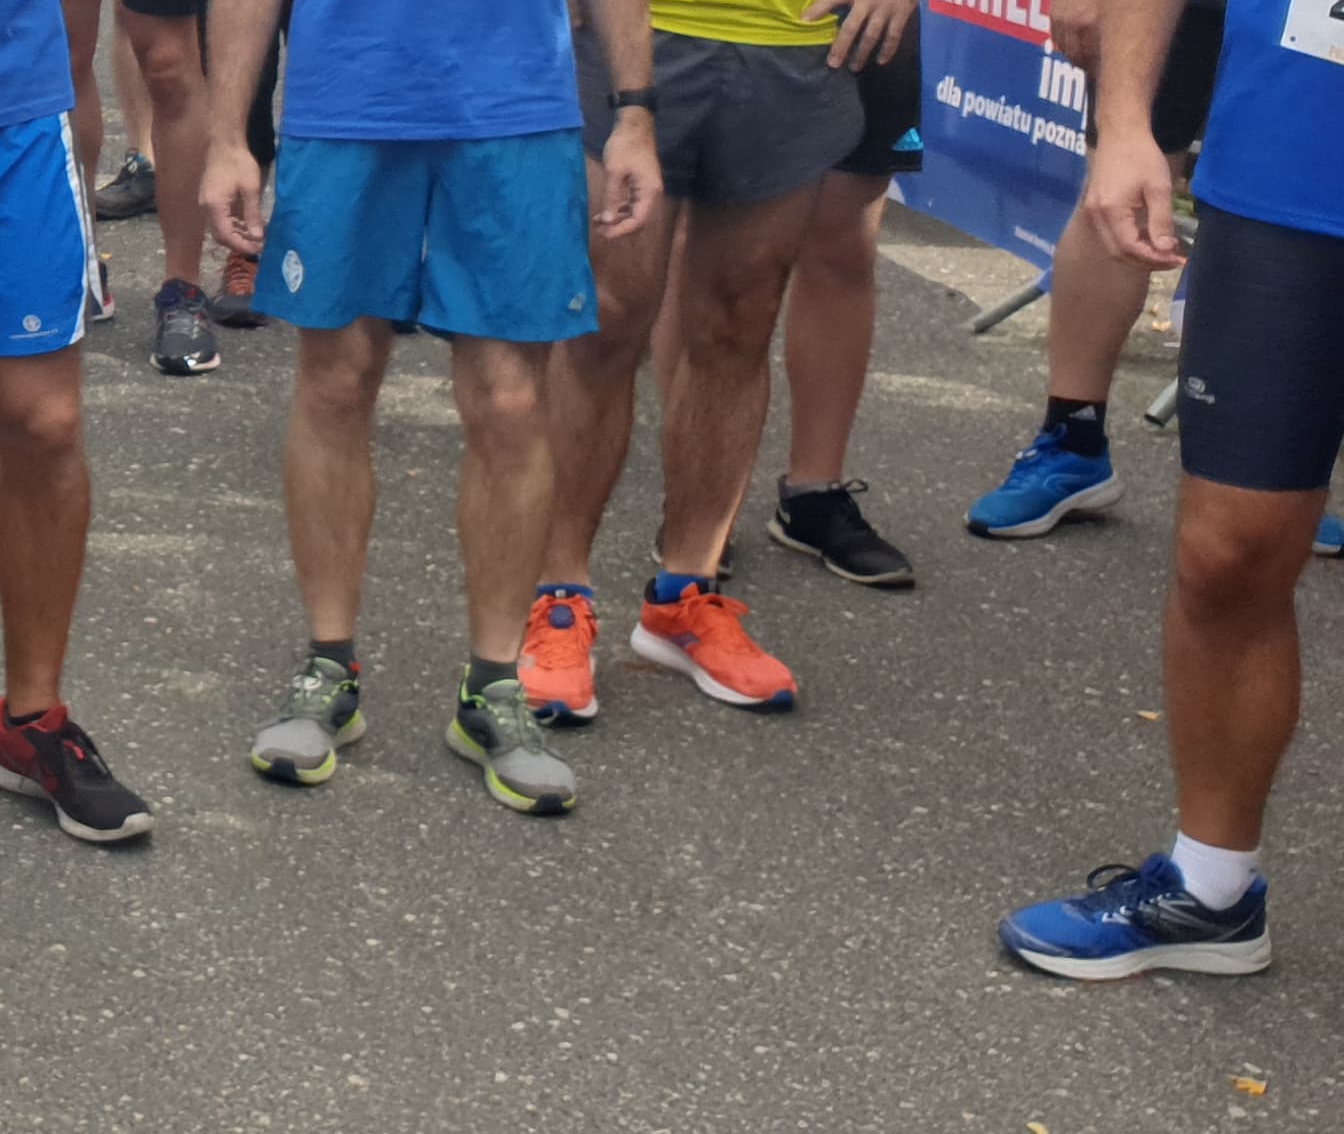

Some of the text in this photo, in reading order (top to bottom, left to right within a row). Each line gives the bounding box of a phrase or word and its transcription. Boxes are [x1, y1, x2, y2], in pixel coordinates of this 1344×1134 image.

[937, 76, 961, 108] dla
[962, 92, 1032, 135] powiatu
[1039, 39, 1088, 130] im
